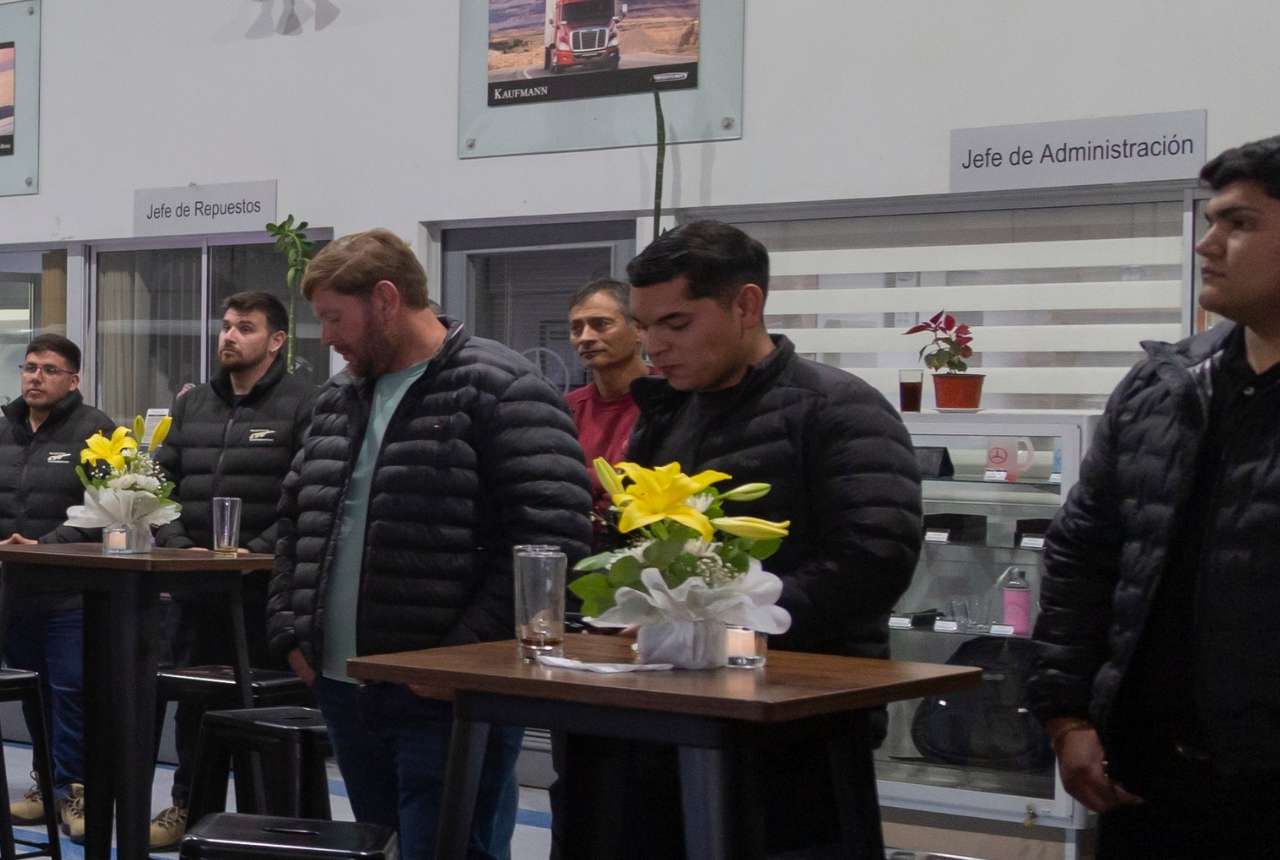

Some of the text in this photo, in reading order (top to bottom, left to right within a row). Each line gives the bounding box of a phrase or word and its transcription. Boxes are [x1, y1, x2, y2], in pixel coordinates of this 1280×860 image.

[494, 86, 548, 100] KAUFMANN
[962, 134, 1194, 169] Jefe de Administración
[146, 199, 261, 219] Jefe de Repuestos
